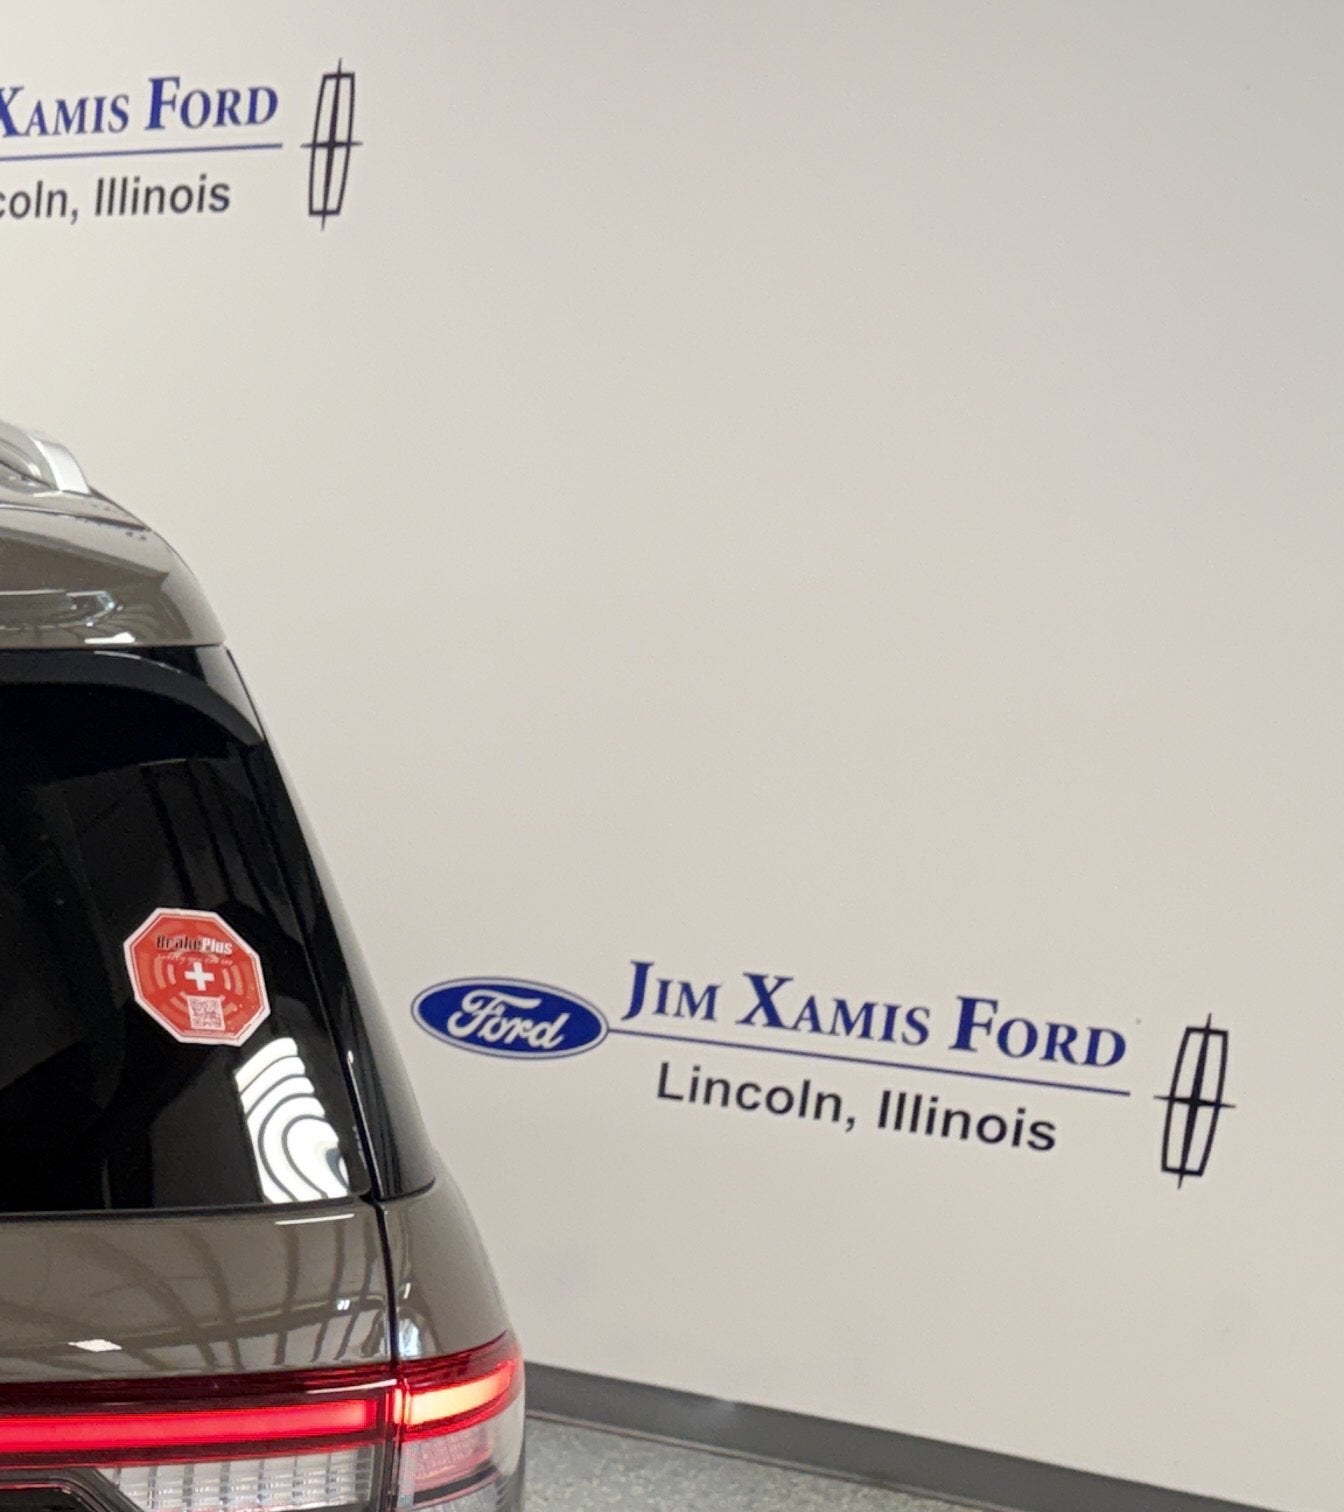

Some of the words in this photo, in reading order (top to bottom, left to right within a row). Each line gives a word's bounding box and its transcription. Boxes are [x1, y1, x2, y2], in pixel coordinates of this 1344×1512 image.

[145, 76, 278, 132] FORD
[94, 174, 230, 217] Illinois
[446, 990, 564, 1049] Ford
[621, 960, 719, 1022] JIM
[735, 972, 929, 1045] XAMIS
[948, 995, 1127, 1067] FORD
[657, 1061, 857, 1133] Lincoln,
[877, 1089, 1057, 1152] Illinois
